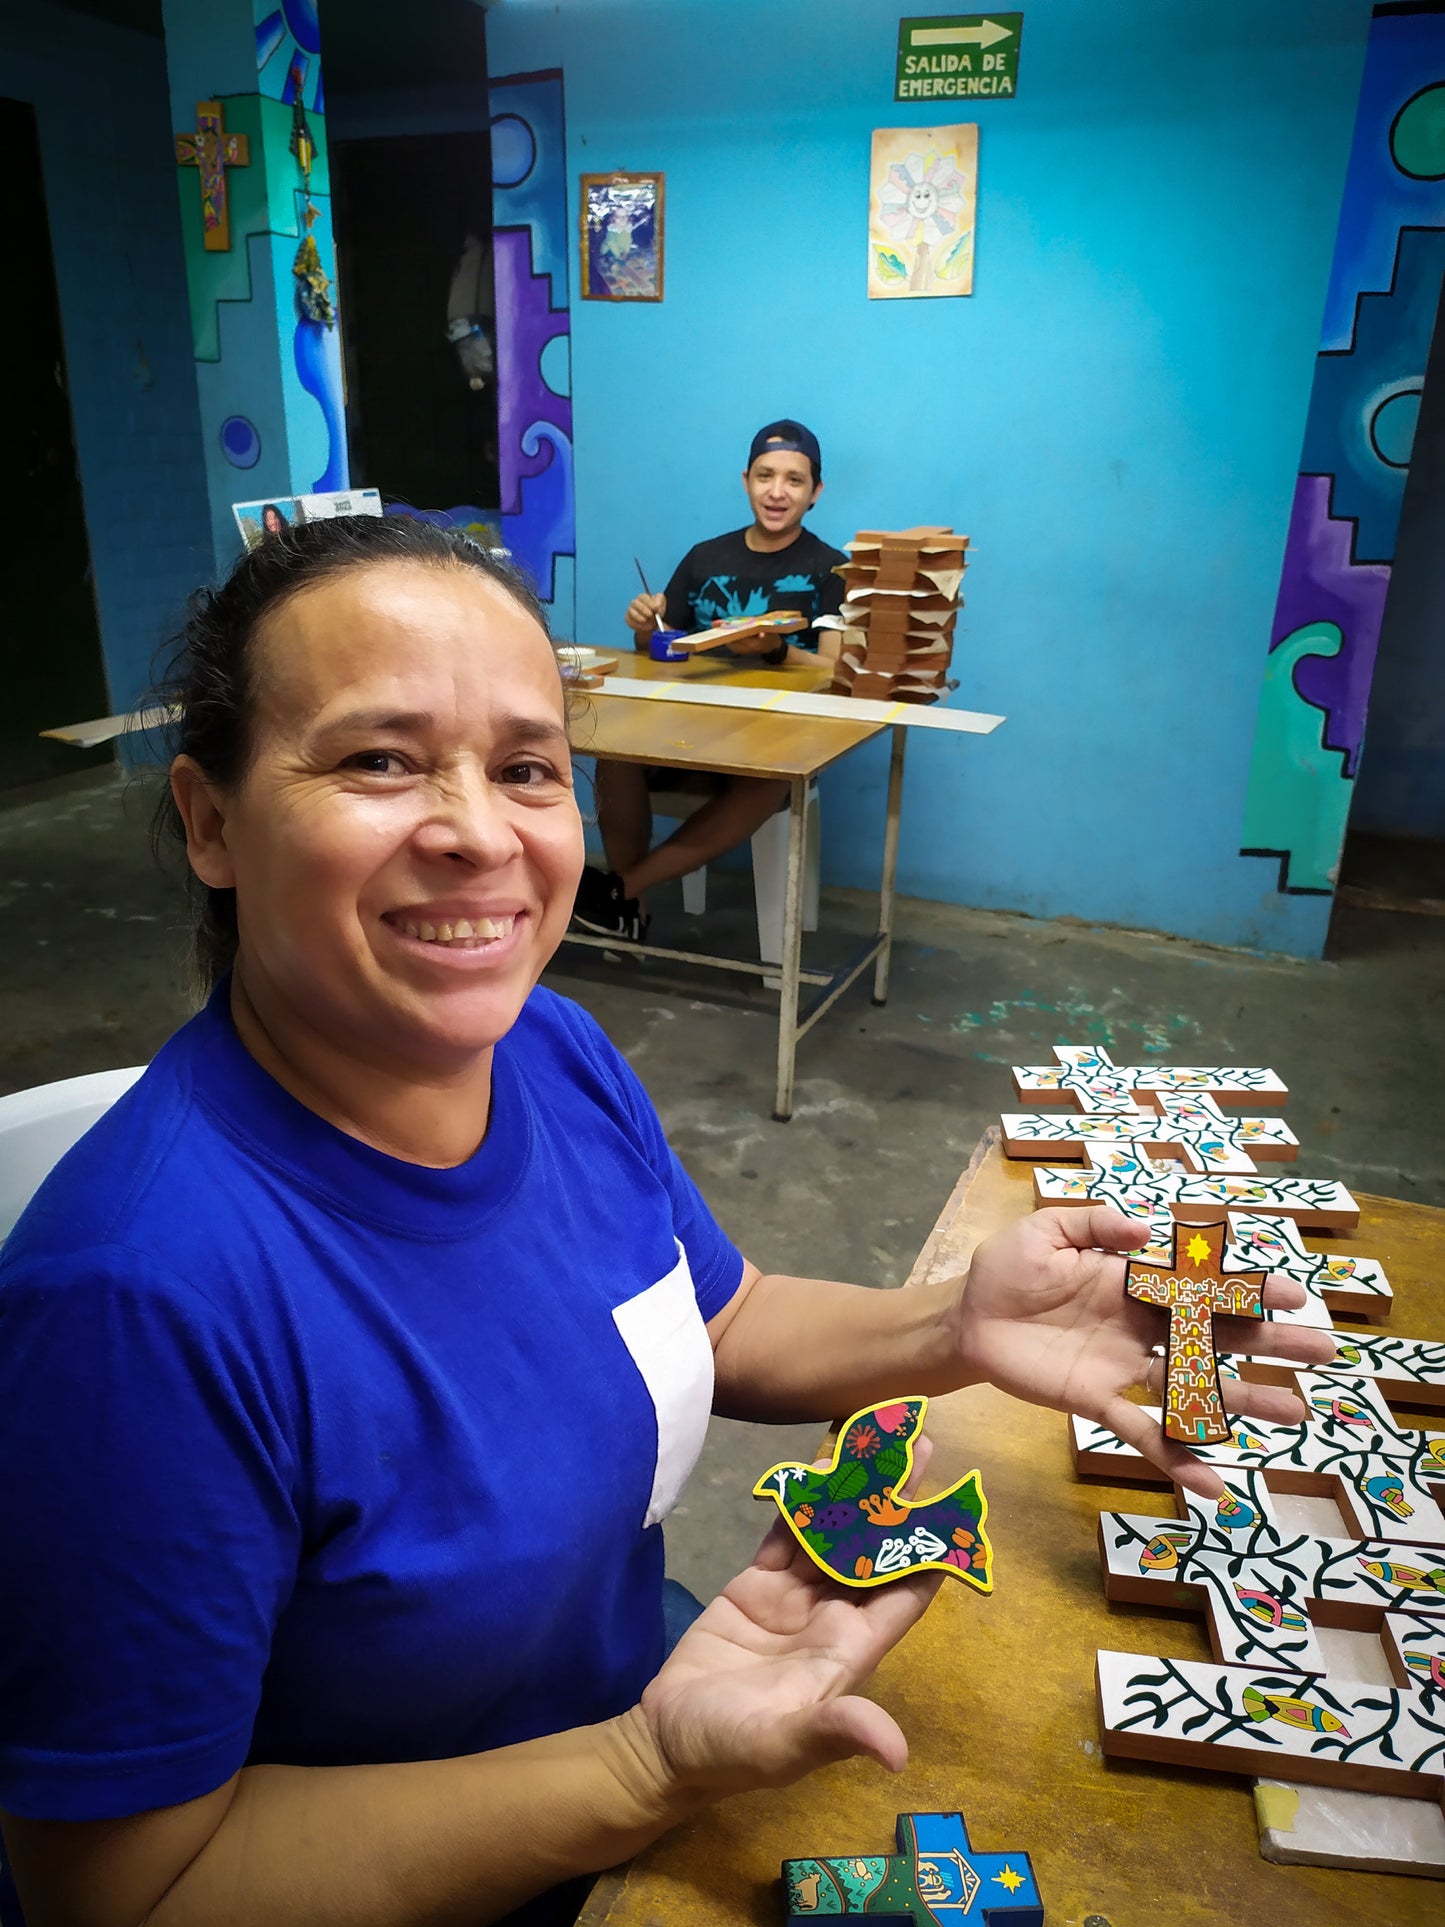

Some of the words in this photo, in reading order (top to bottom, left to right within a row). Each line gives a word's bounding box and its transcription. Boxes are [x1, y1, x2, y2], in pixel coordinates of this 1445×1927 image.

[905, 54, 972, 74] SALIDA
[982, 53, 1006, 72] DE
[899, 76, 1013, 97] EMERGENCIA
